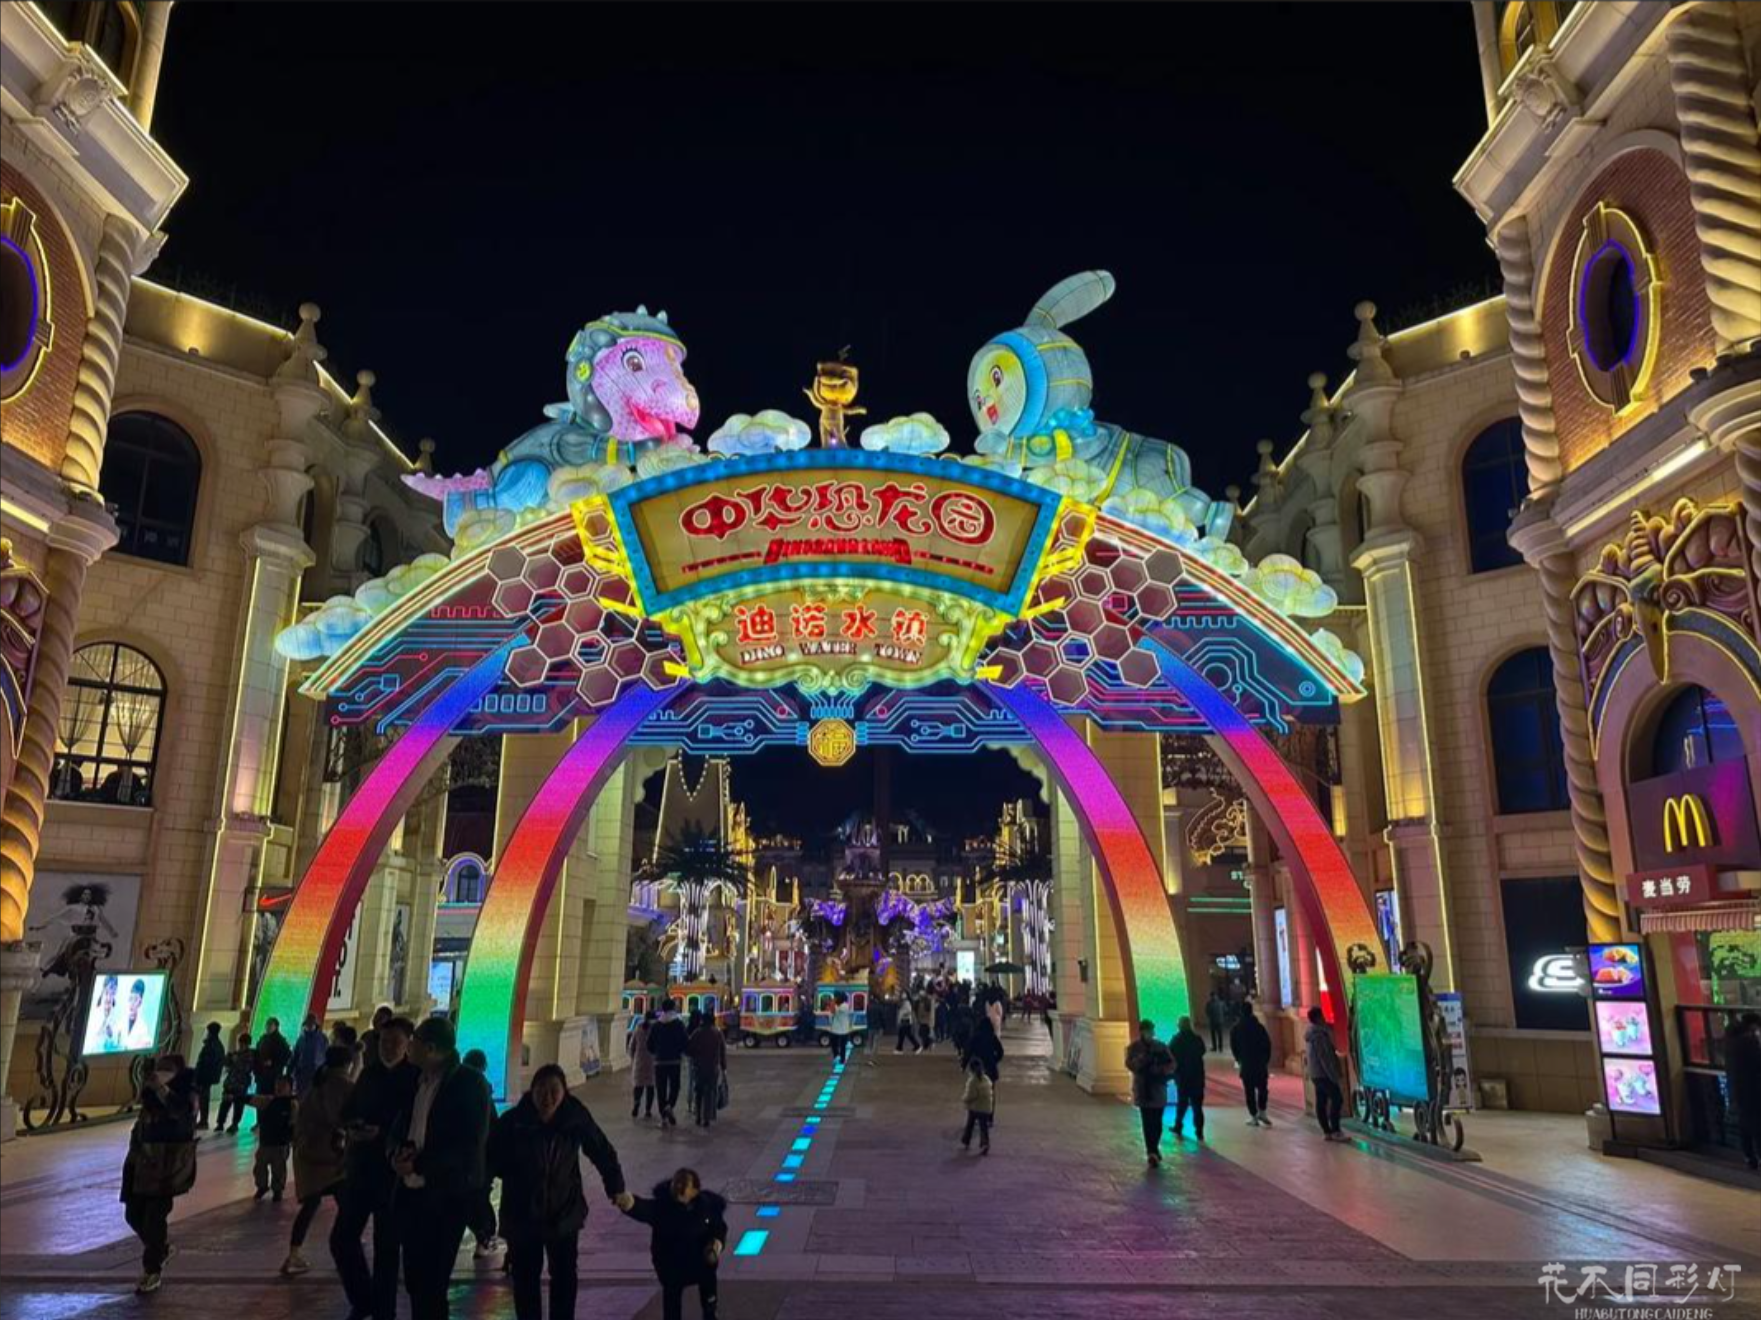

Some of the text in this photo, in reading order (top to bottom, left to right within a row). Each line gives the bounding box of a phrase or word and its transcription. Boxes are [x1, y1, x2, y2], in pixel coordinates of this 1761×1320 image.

[734, 603, 929, 647] 迪诺水镇
[740, 640, 922, 665] DINO WATER TOWN
[1641, 874, 1691, 899] 麦当劳
